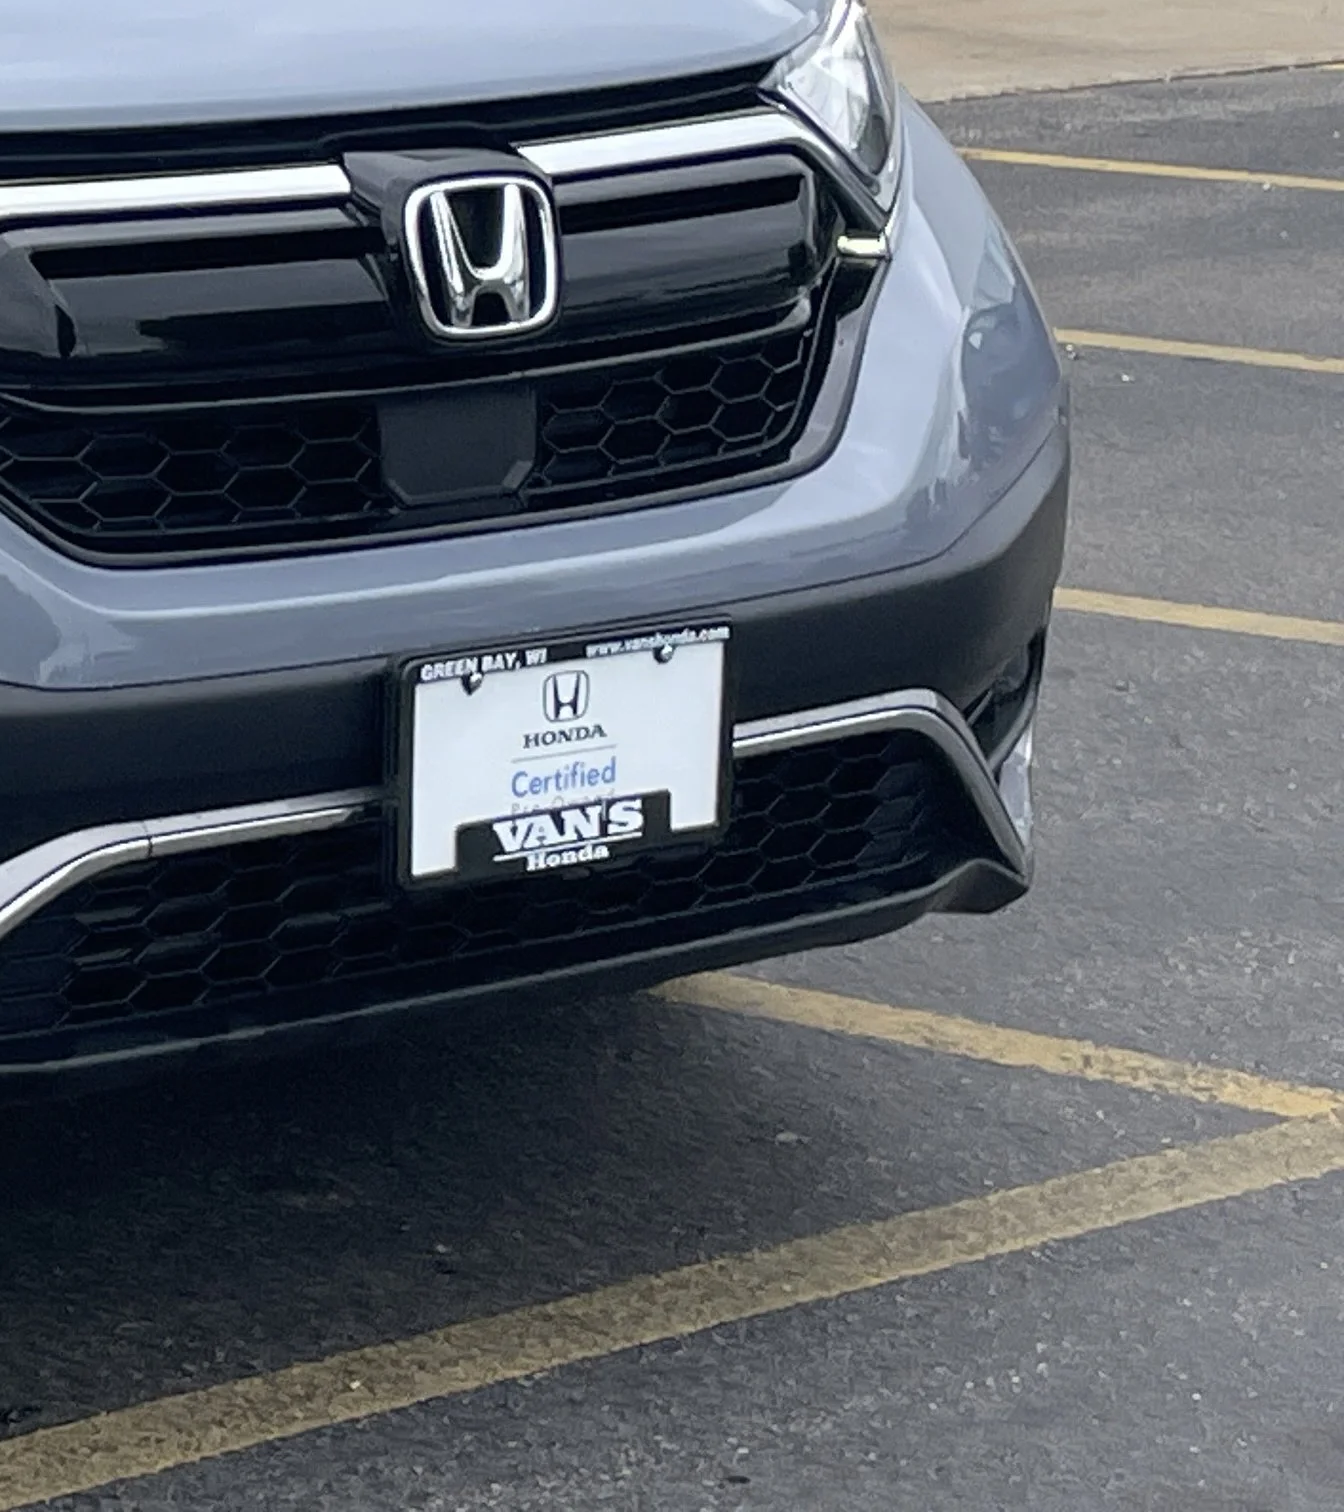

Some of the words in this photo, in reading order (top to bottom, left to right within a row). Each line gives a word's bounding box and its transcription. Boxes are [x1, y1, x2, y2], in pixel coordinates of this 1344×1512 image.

[420, 656, 479, 682] GREEN
[481, 652, 522, 672] BAY,
[525, 647, 548, 666] WI
[522, 724, 607, 749] HONDA
[511, 756, 617, 798] Certified
[526, 843, 610, 872] Honda
